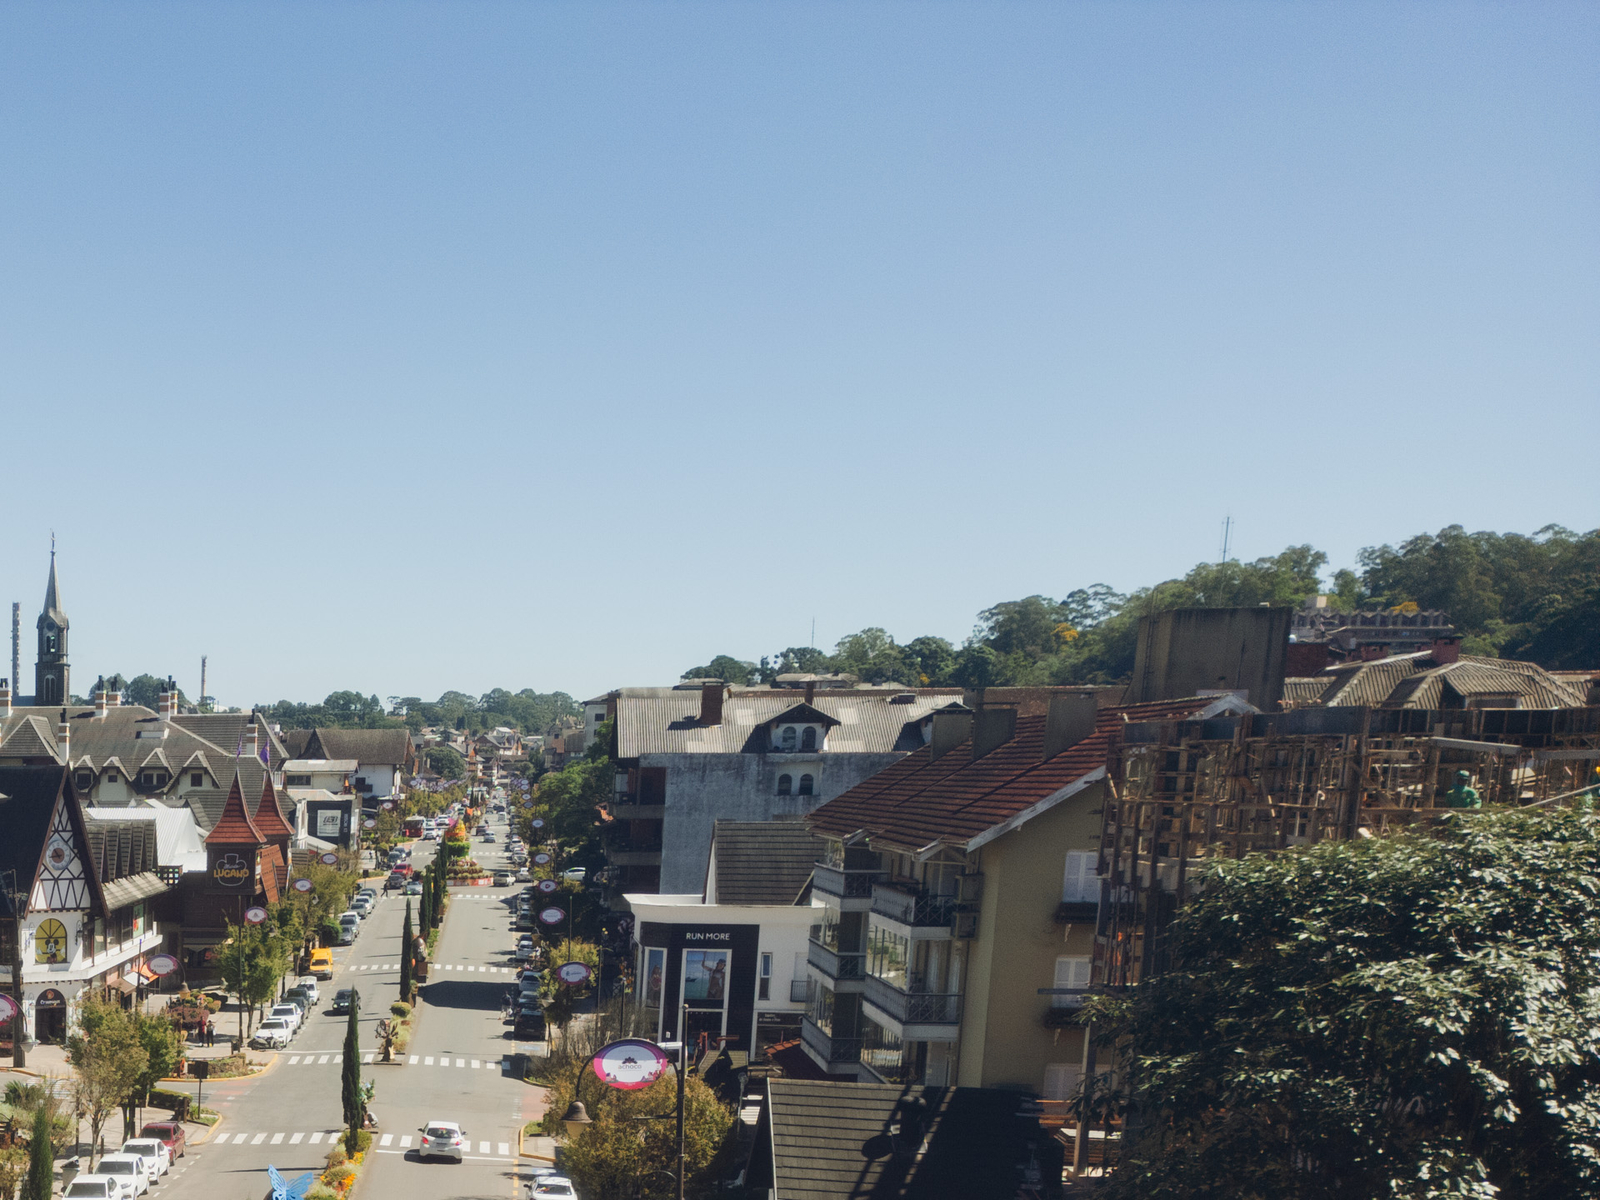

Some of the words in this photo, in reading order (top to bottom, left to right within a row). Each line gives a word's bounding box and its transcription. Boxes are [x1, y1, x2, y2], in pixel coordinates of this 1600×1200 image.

[213, 868, 250, 878] LUGANO
[686, 932, 704, 940] RUN
[706, 932, 731, 941] MORE
